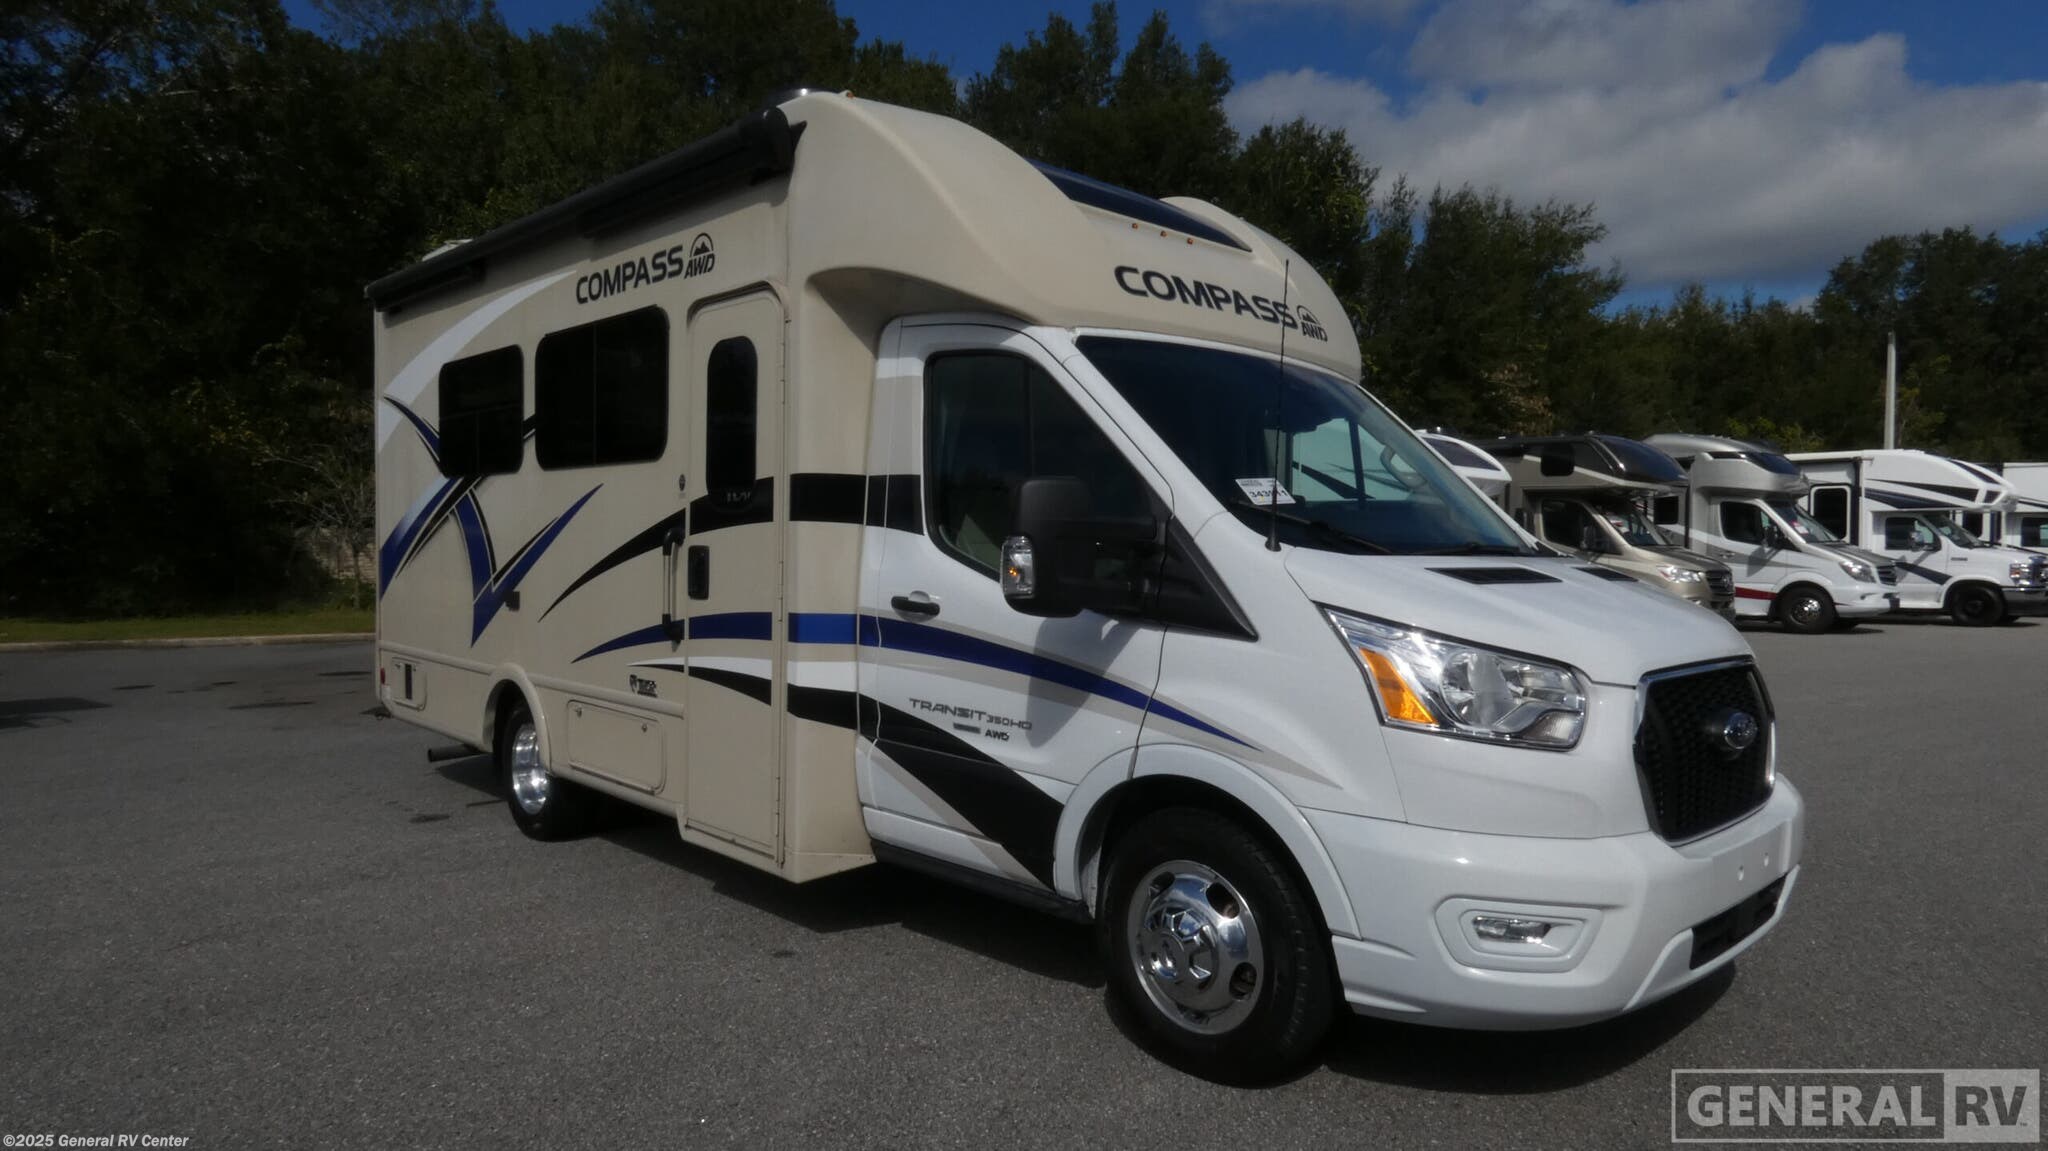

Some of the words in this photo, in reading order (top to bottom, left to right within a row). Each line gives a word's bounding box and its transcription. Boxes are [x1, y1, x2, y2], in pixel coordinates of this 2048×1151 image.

[576, 245, 683, 304] COMPASS
[684, 253, 715, 279] AWD
[1114, 265, 1298, 330] COMPASS
[1301, 321, 1328, 342] AWD
[909, 698, 986, 721] TRANSIT
[985, 728, 1009, 741] AWD
